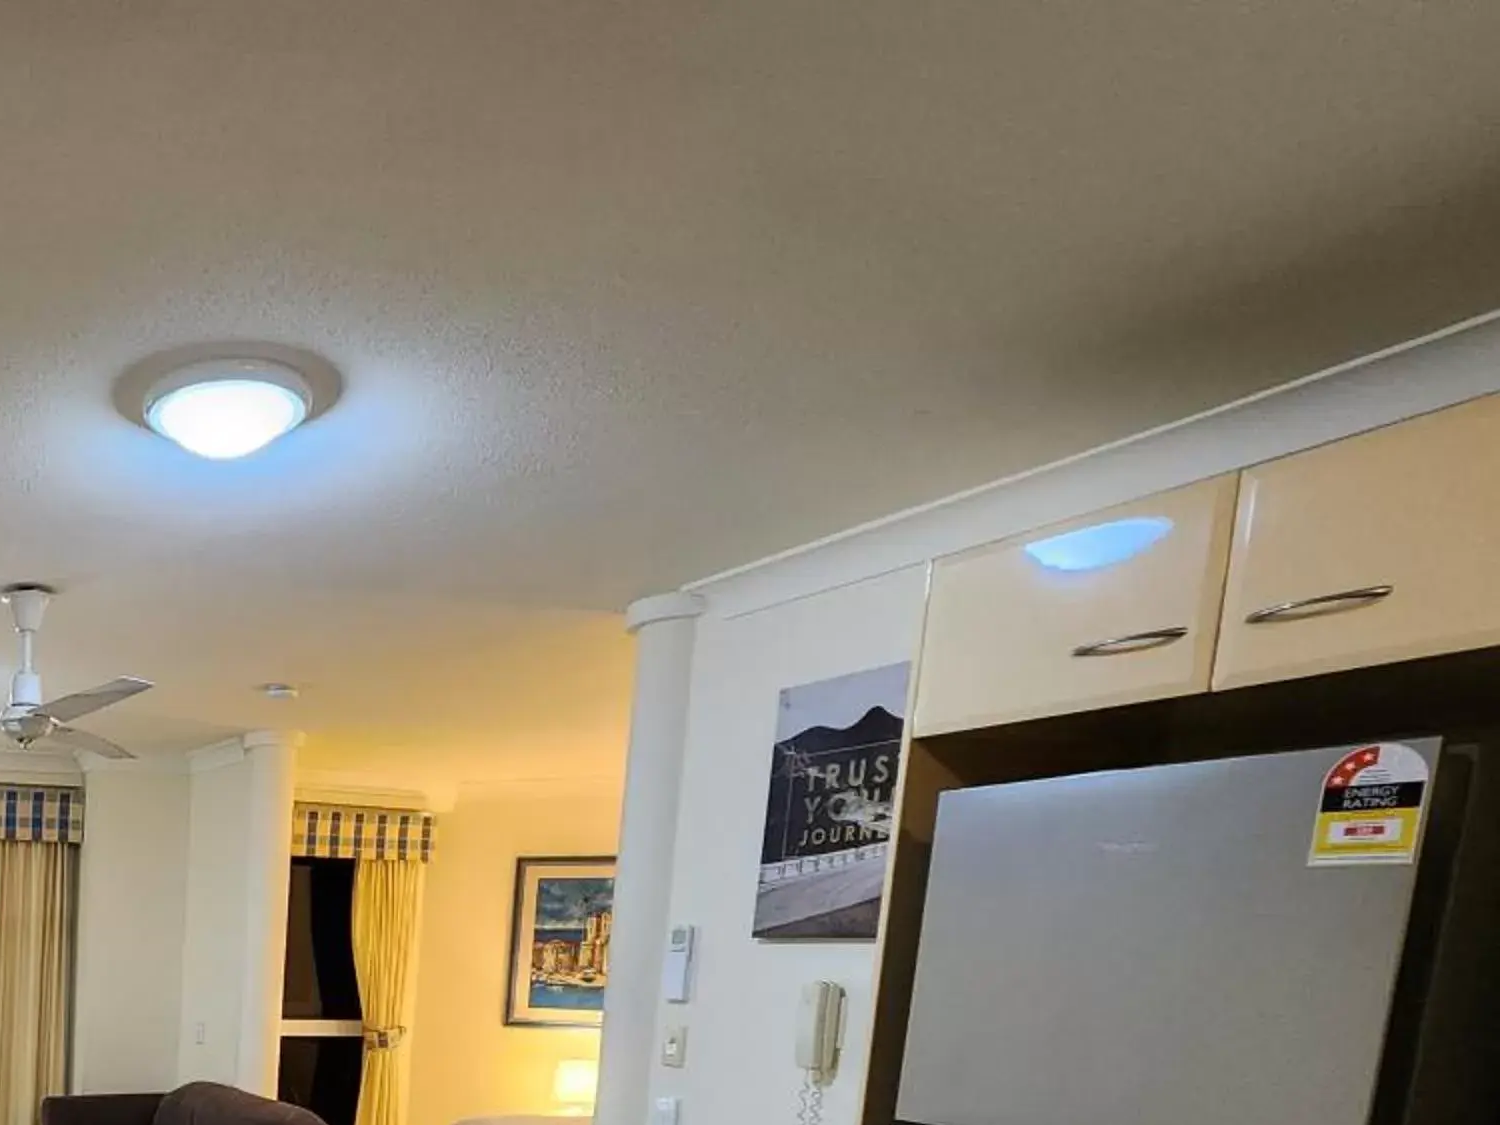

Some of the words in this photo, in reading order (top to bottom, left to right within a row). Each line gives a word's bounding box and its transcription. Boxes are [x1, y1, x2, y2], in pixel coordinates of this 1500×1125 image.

[803, 753, 901, 792] TRUS
[803, 786, 896, 824] YOU
[1342, 796, 1398, 809] RATING
[1343, 785, 1400, 799] ENERGY
